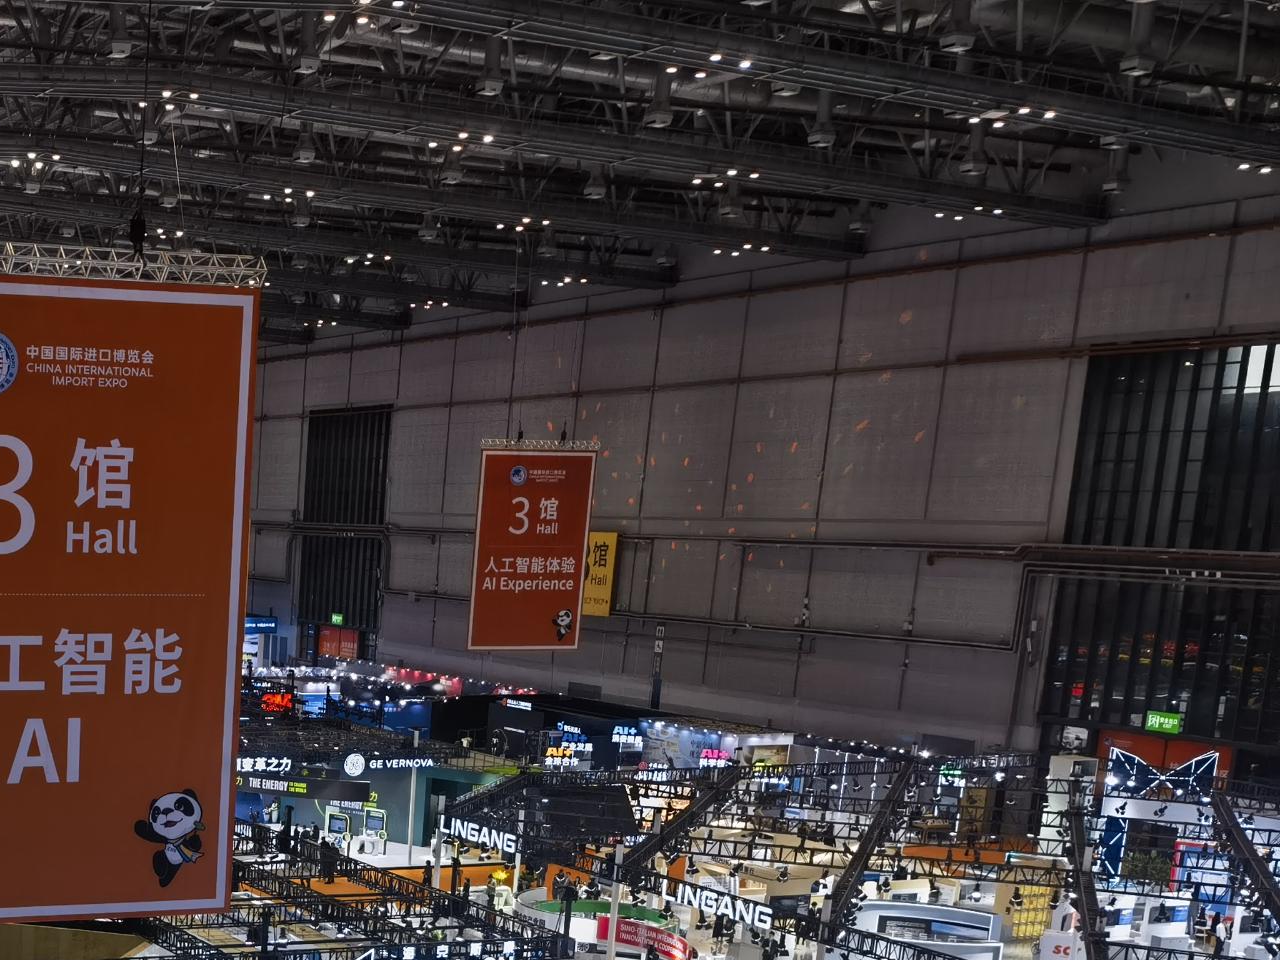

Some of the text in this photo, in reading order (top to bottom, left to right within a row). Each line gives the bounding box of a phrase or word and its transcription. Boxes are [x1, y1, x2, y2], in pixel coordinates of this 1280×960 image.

[26, 345, 154, 365] 中国国际进口博览会
[26, 363, 154, 378] CHINA INTERNATIONAL
[52, 375, 129, 388] IMPORT EXPO
[69, 437, 134, 509] 馆
[508, 497, 530, 535] 3
[539, 498, 559, 520] 馆
[66, 519, 138, 555] Hall
[536, 523, 558, 534] Hall
[592, 541, 609, 568] 馆
[484, 556, 576, 574] 人工智能体验
[482, 577, 574, 593] AI Experience
[590, 573, 607, 586] Hall
[613, 726, 637, 735] AI+
[7, 717, 81, 785] AI
[546, 747, 573, 757] AI+
[700, 749, 729, 759] AI+
[370, 759, 434, 769] GE VERNOVA
[249, 778, 288, 791] THE ENERGY
[439, 815, 517, 854] LINGANG
[661, 879, 773, 931] LINGANG
